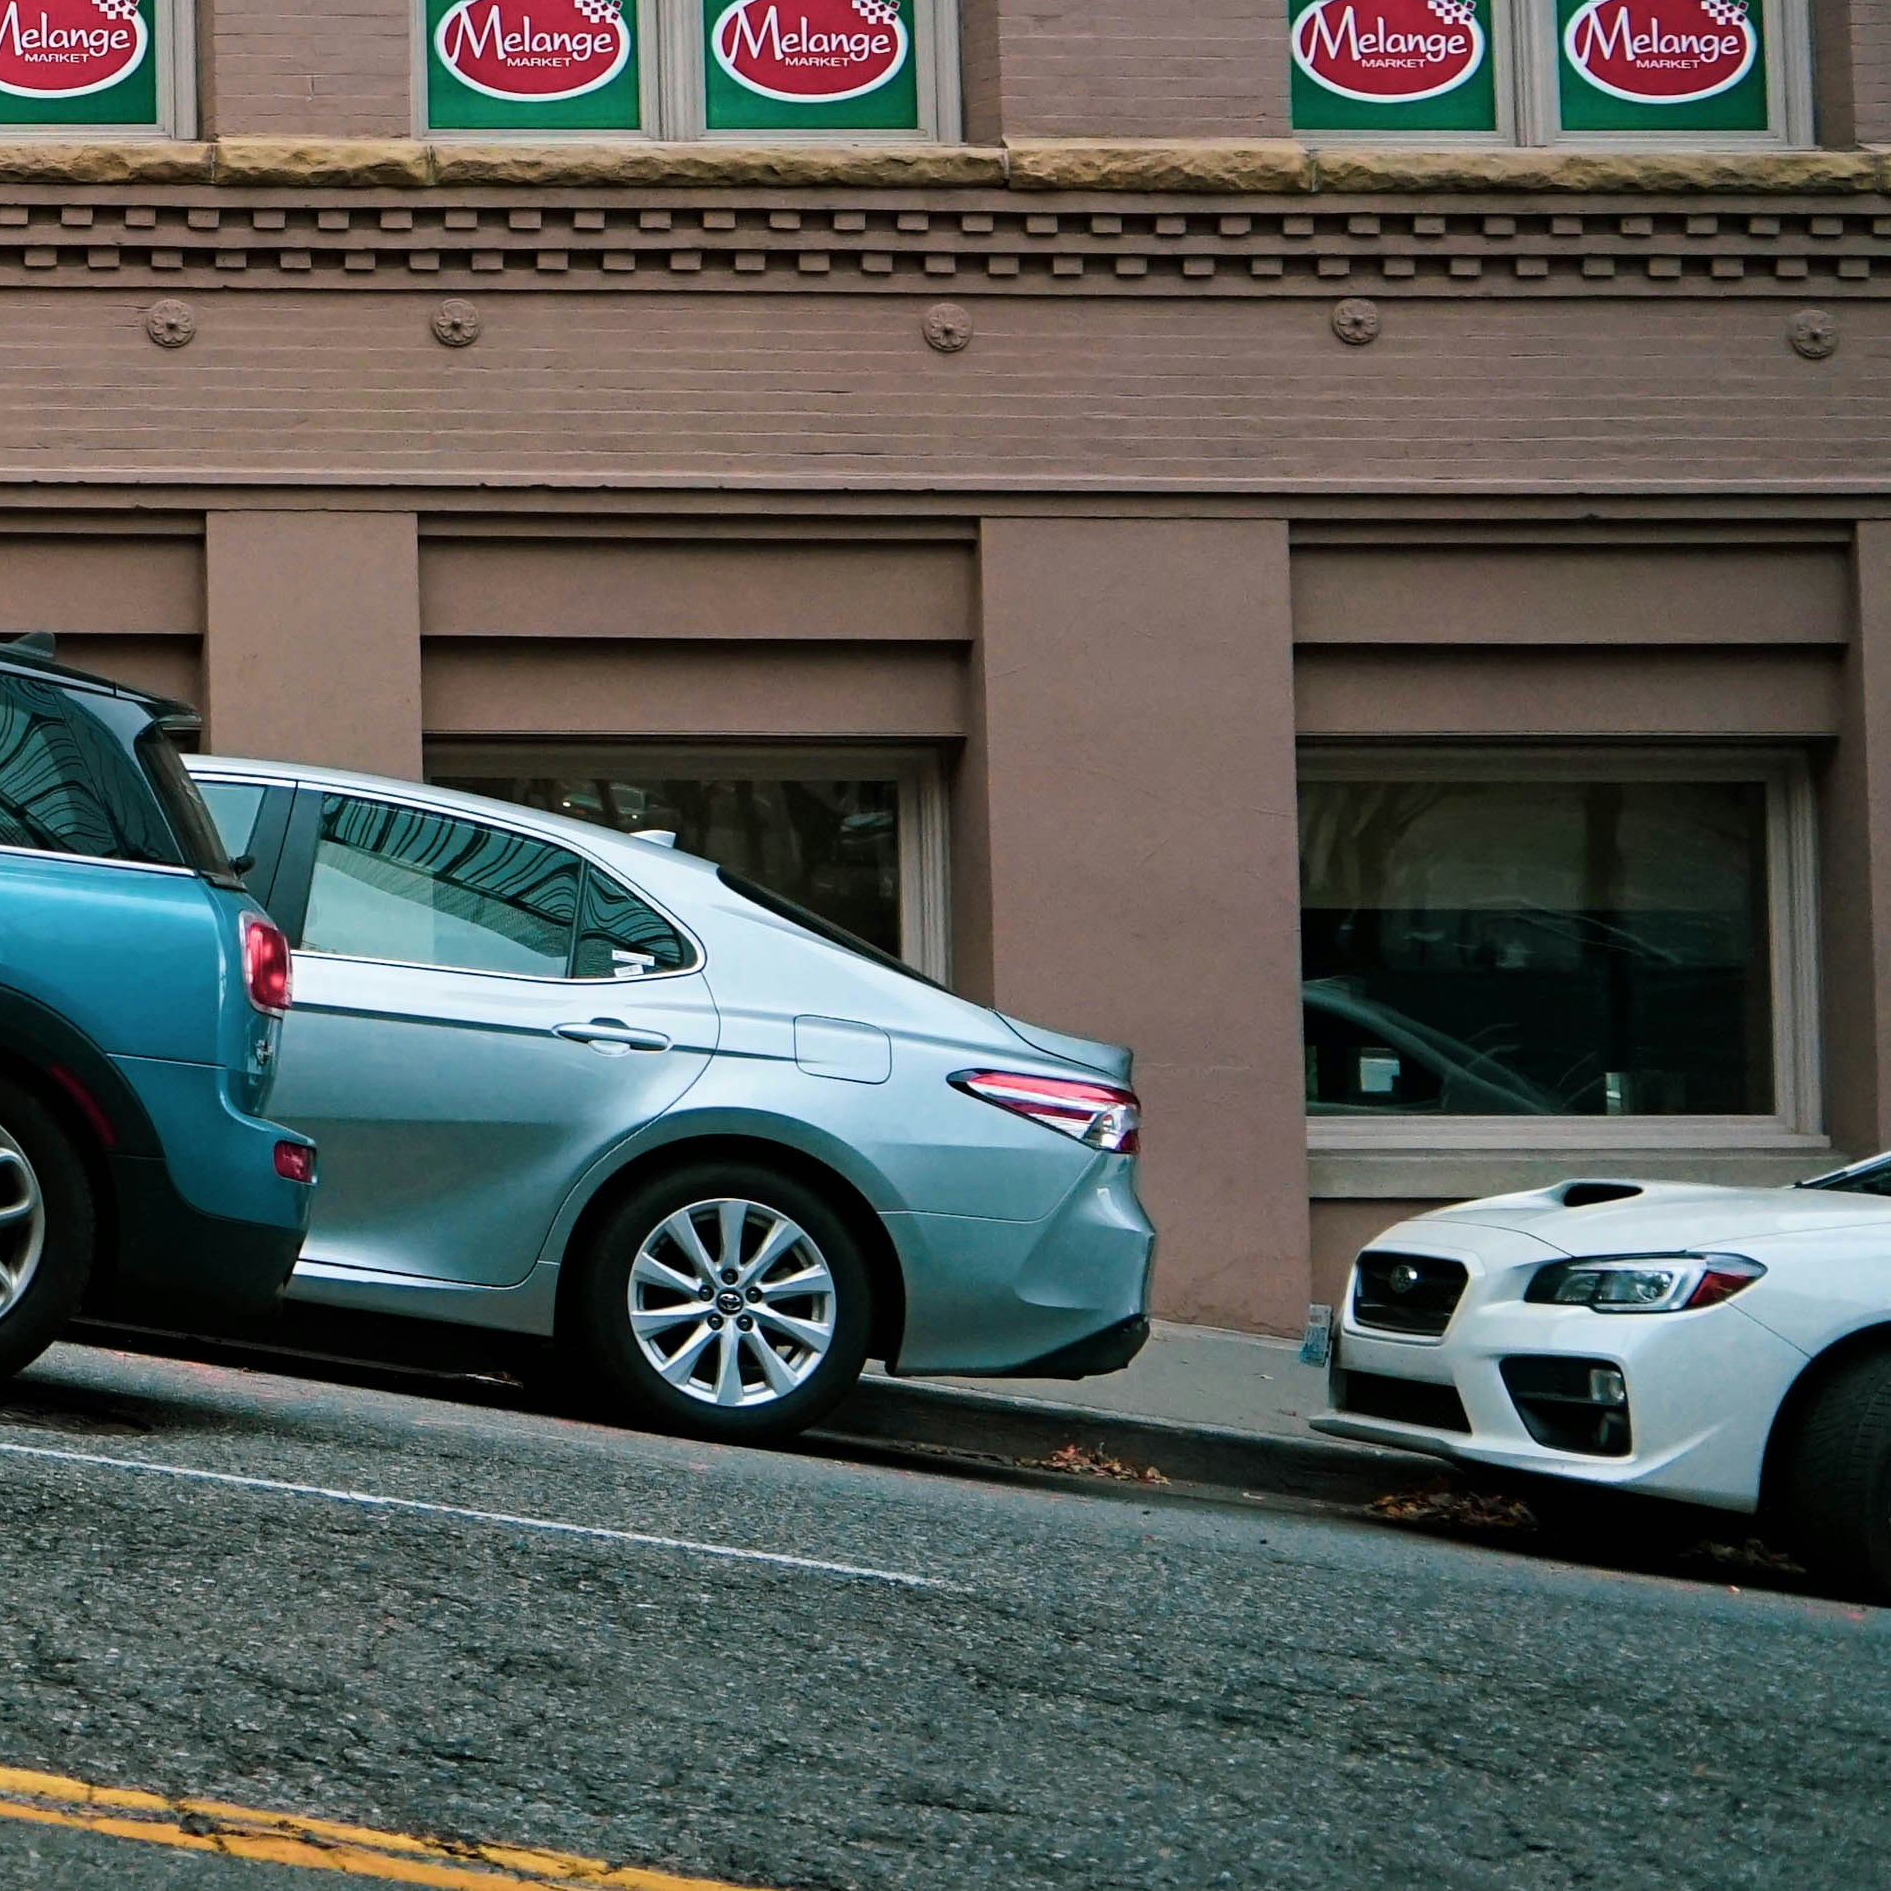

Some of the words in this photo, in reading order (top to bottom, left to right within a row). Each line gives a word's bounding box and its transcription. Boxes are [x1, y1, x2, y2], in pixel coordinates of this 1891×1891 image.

[449, 4, 614, 61] Melange
[727, 5, 892, 62] Melange
[1305, 5, 1468, 63] Melange
[1580, 6, 1740, 63] Melange
[24, 53, 89, 63] MARKET
[507, 57, 572, 67] MARKET
[785, 57, 850, 67] MARKET
[1361, 59, 1426, 69] MARKET
[1636, 59, 1701, 69] MARKET
